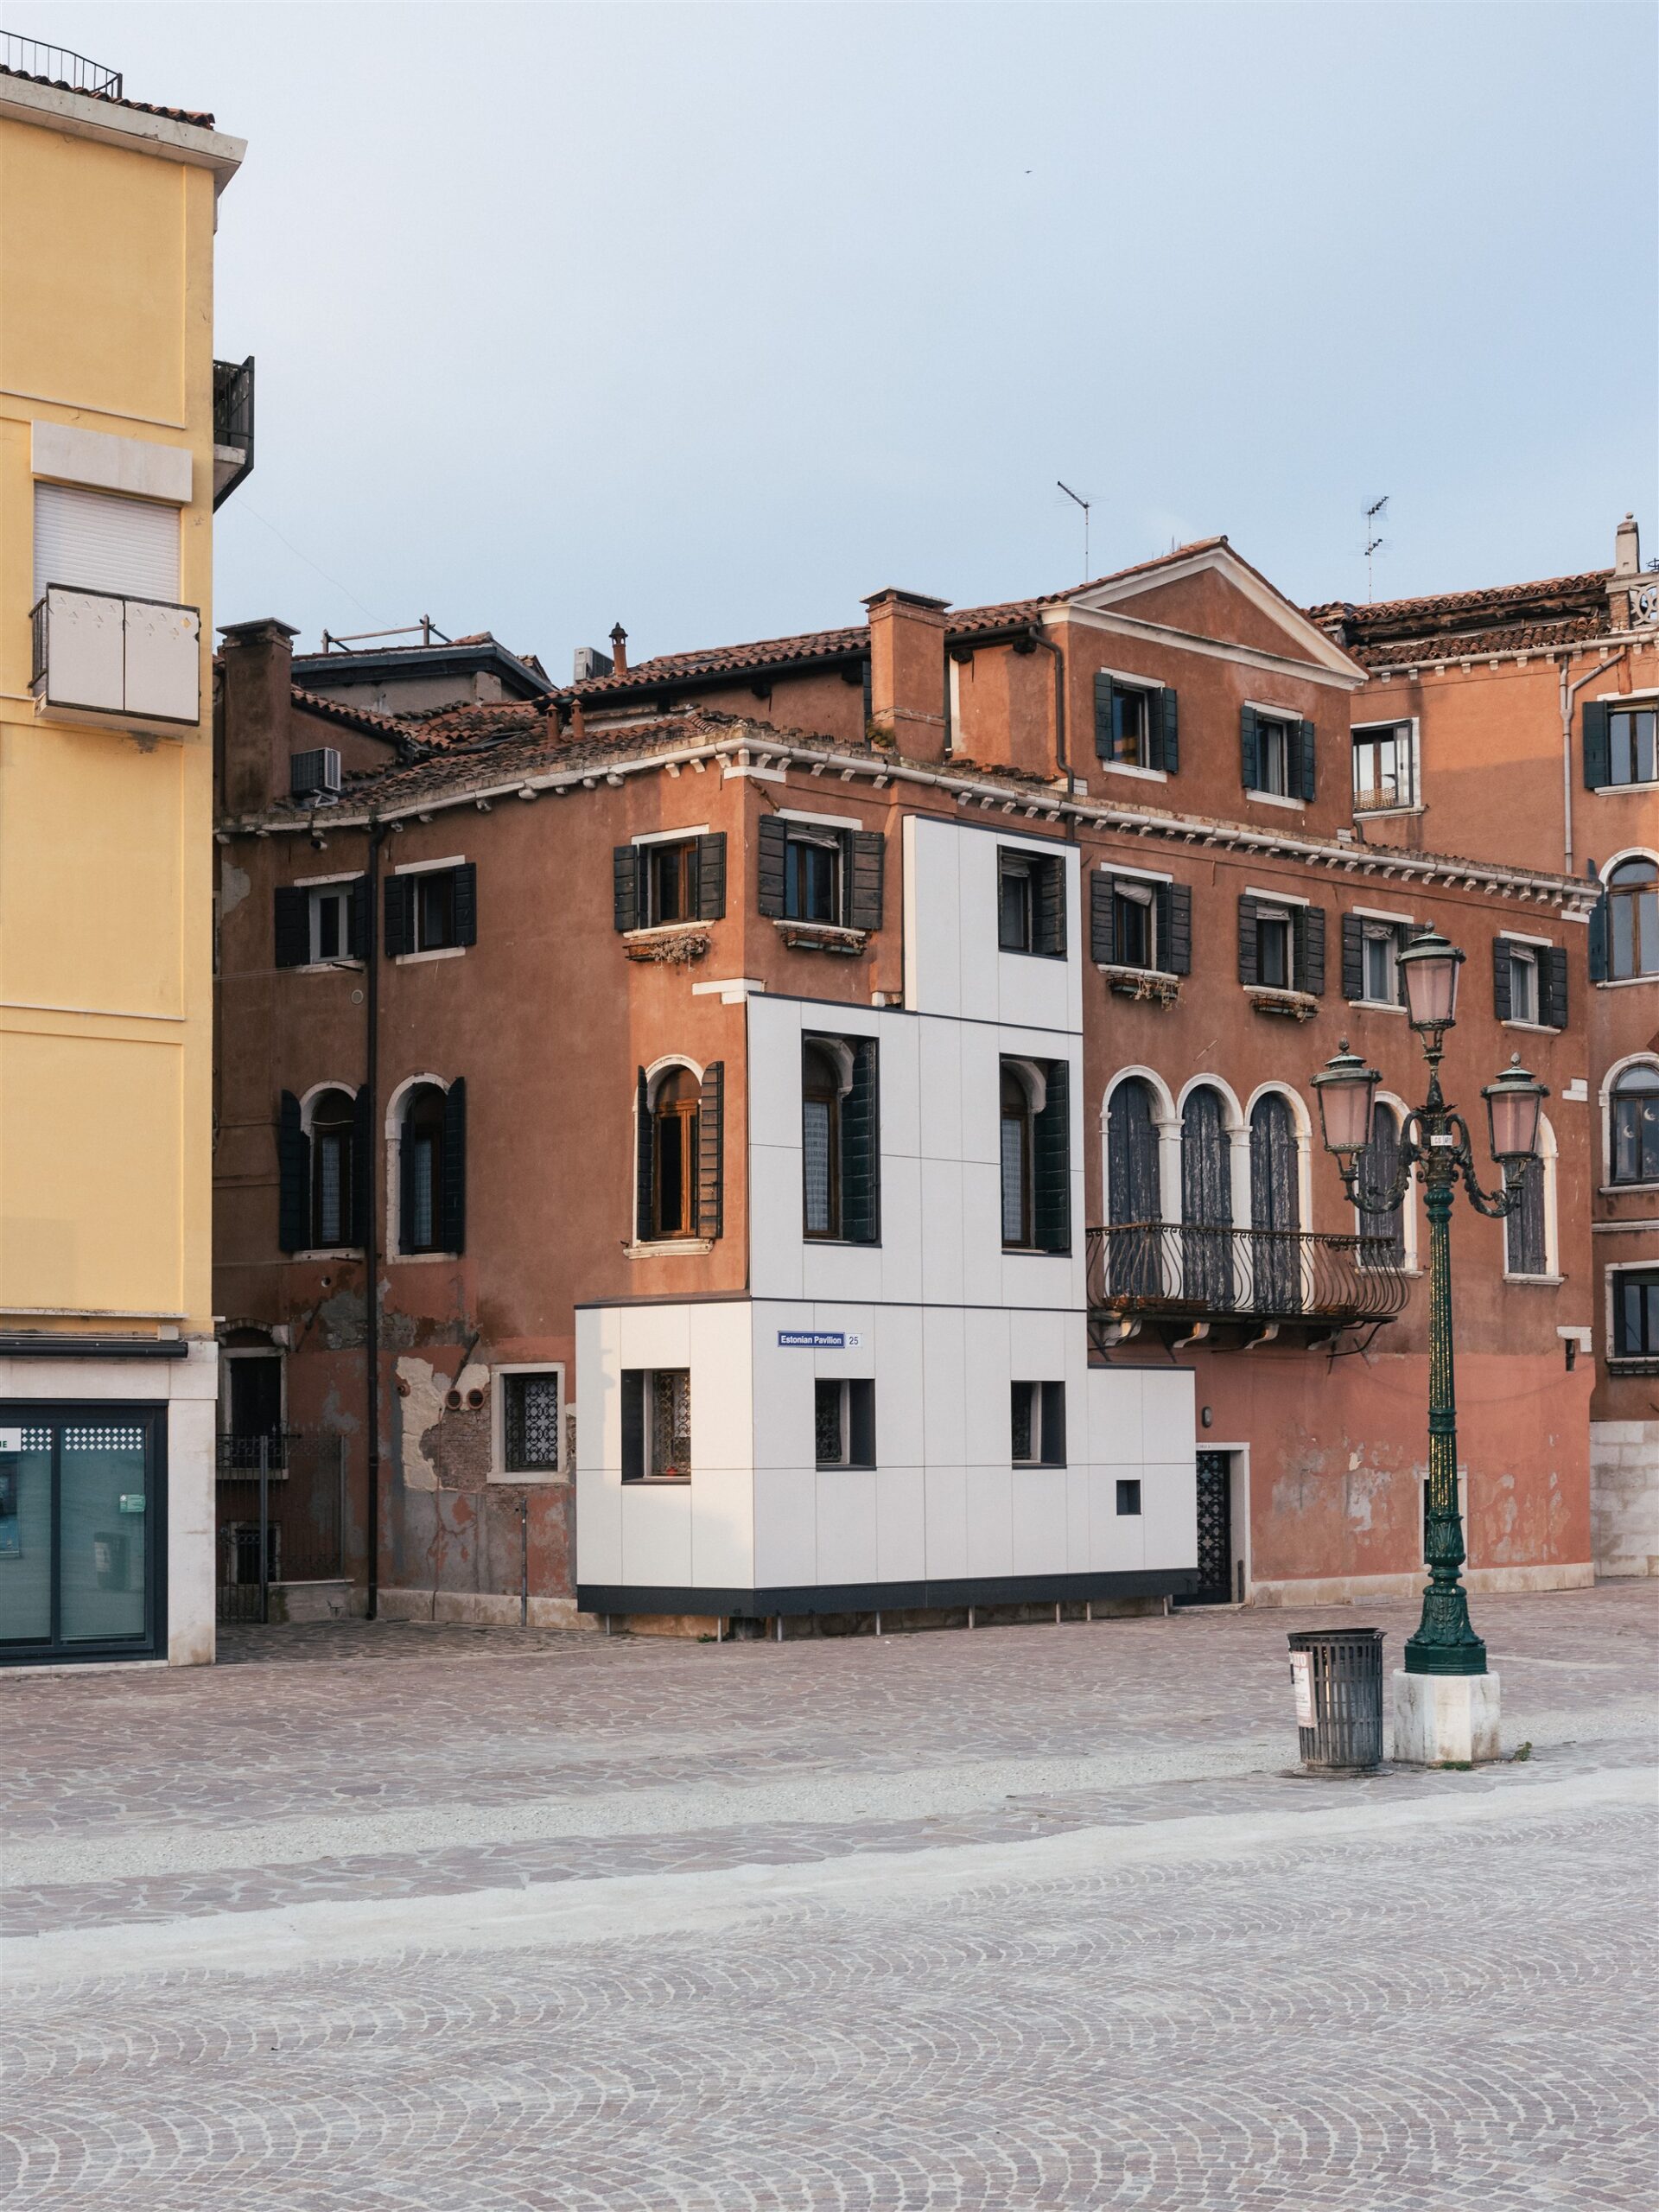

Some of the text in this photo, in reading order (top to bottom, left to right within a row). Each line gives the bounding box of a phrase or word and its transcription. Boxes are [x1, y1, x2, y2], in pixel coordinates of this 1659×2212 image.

[780, 1335, 859, 1345] Estonian Pavilion 25
